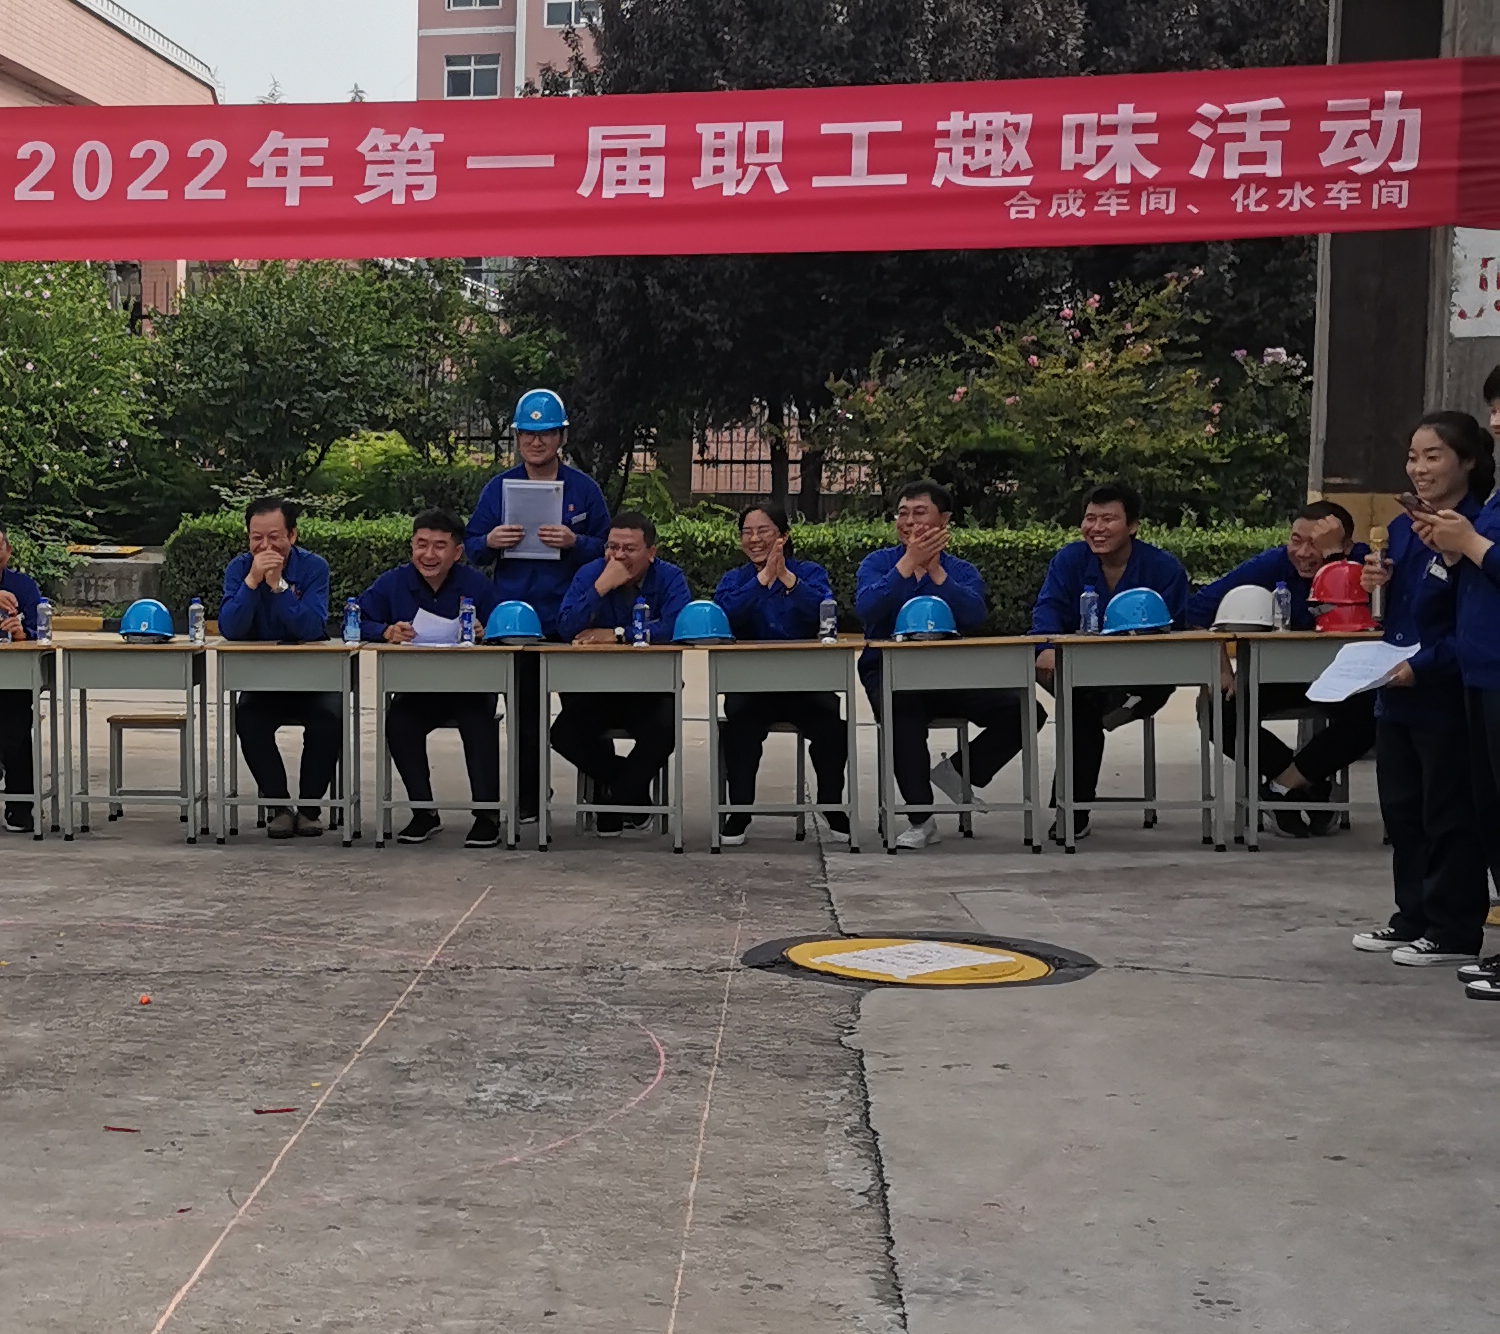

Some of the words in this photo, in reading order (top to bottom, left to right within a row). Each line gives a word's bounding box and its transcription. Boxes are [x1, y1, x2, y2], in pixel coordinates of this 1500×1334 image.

[1004, 179, 1410, 220] 合成车间、化水车间
